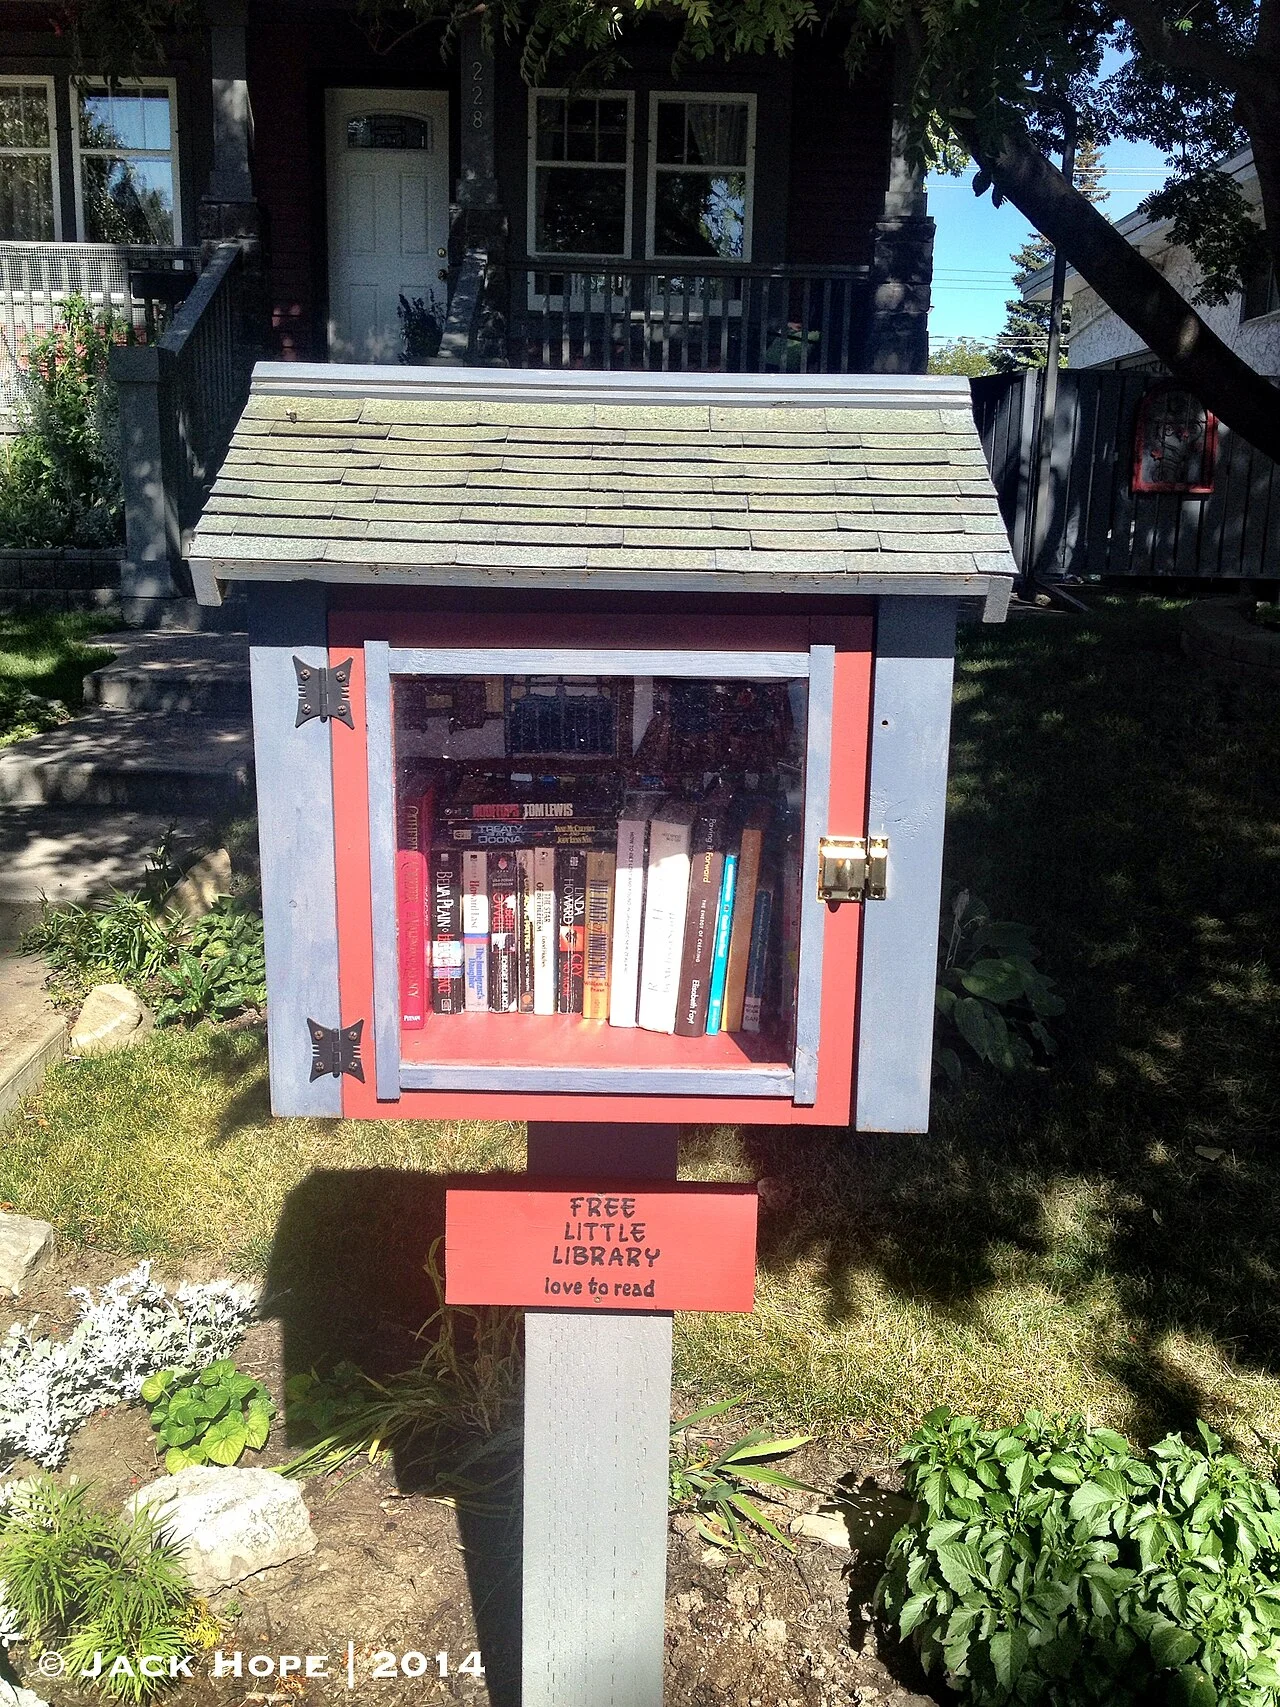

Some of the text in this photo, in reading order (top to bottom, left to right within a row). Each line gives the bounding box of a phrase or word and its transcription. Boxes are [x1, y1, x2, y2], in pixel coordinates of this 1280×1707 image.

[471, 61, 483, 128] 228
[522, 803, 544, 820] TOM
[545, 803, 574, 817] LEWIS
[478, 825, 523, 834] TREATY
[705, 818, 717, 843] Paving
[702, 851, 714, 883] Forward
[436, 871, 455, 929] BELVA PLAIN
[563, 878, 574, 924] HOWARD
[574, 887, 585, 916] LINDA
[476, 948, 484, 960] The
[572, 953, 583, 978] CRY
[588, 932, 608, 979] INNOCENCE
[467, 958, 476, 989] Daughter
[570, 1196, 636, 1218] FREE
[564, 1221, 646, 1243] LITTLE
[551, 1245, 661, 1268] LIBRARY
[544, 1276, 656, 1298] love to read
